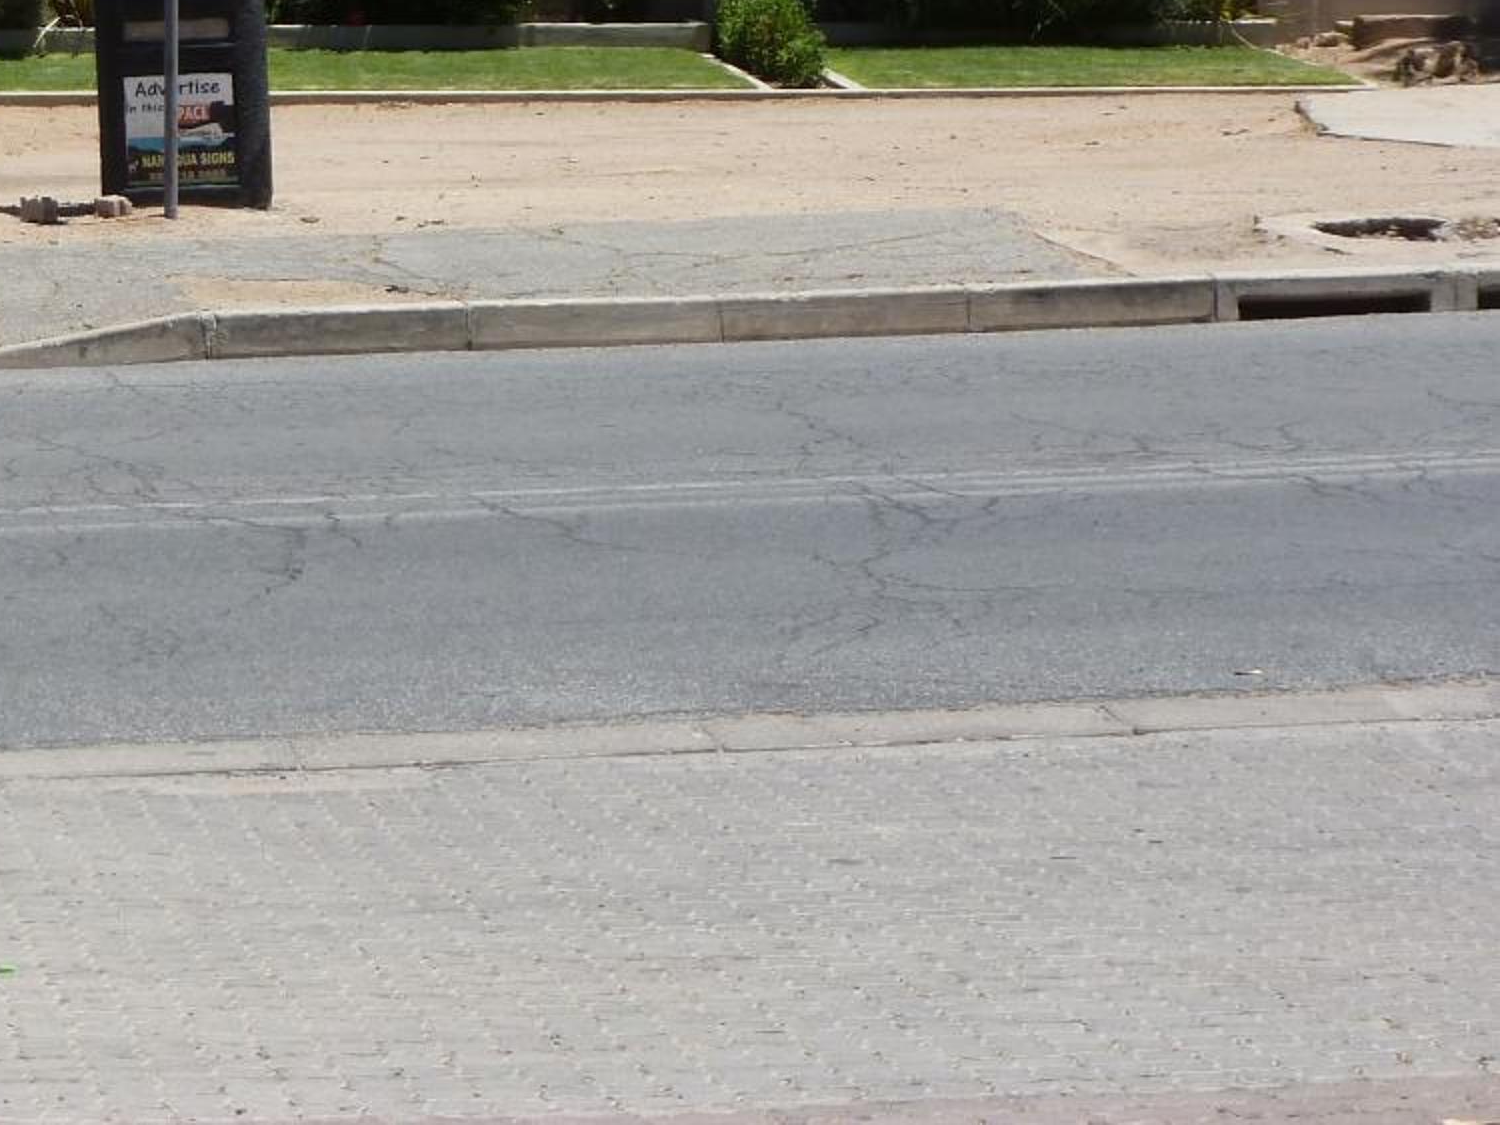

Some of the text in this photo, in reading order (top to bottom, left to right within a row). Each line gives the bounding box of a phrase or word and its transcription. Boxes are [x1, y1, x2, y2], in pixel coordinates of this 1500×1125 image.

[135, 80, 221, 97] Advrtise
[176, 105, 209, 121] PACE
[200, 151, 236, 165] SIGNS
